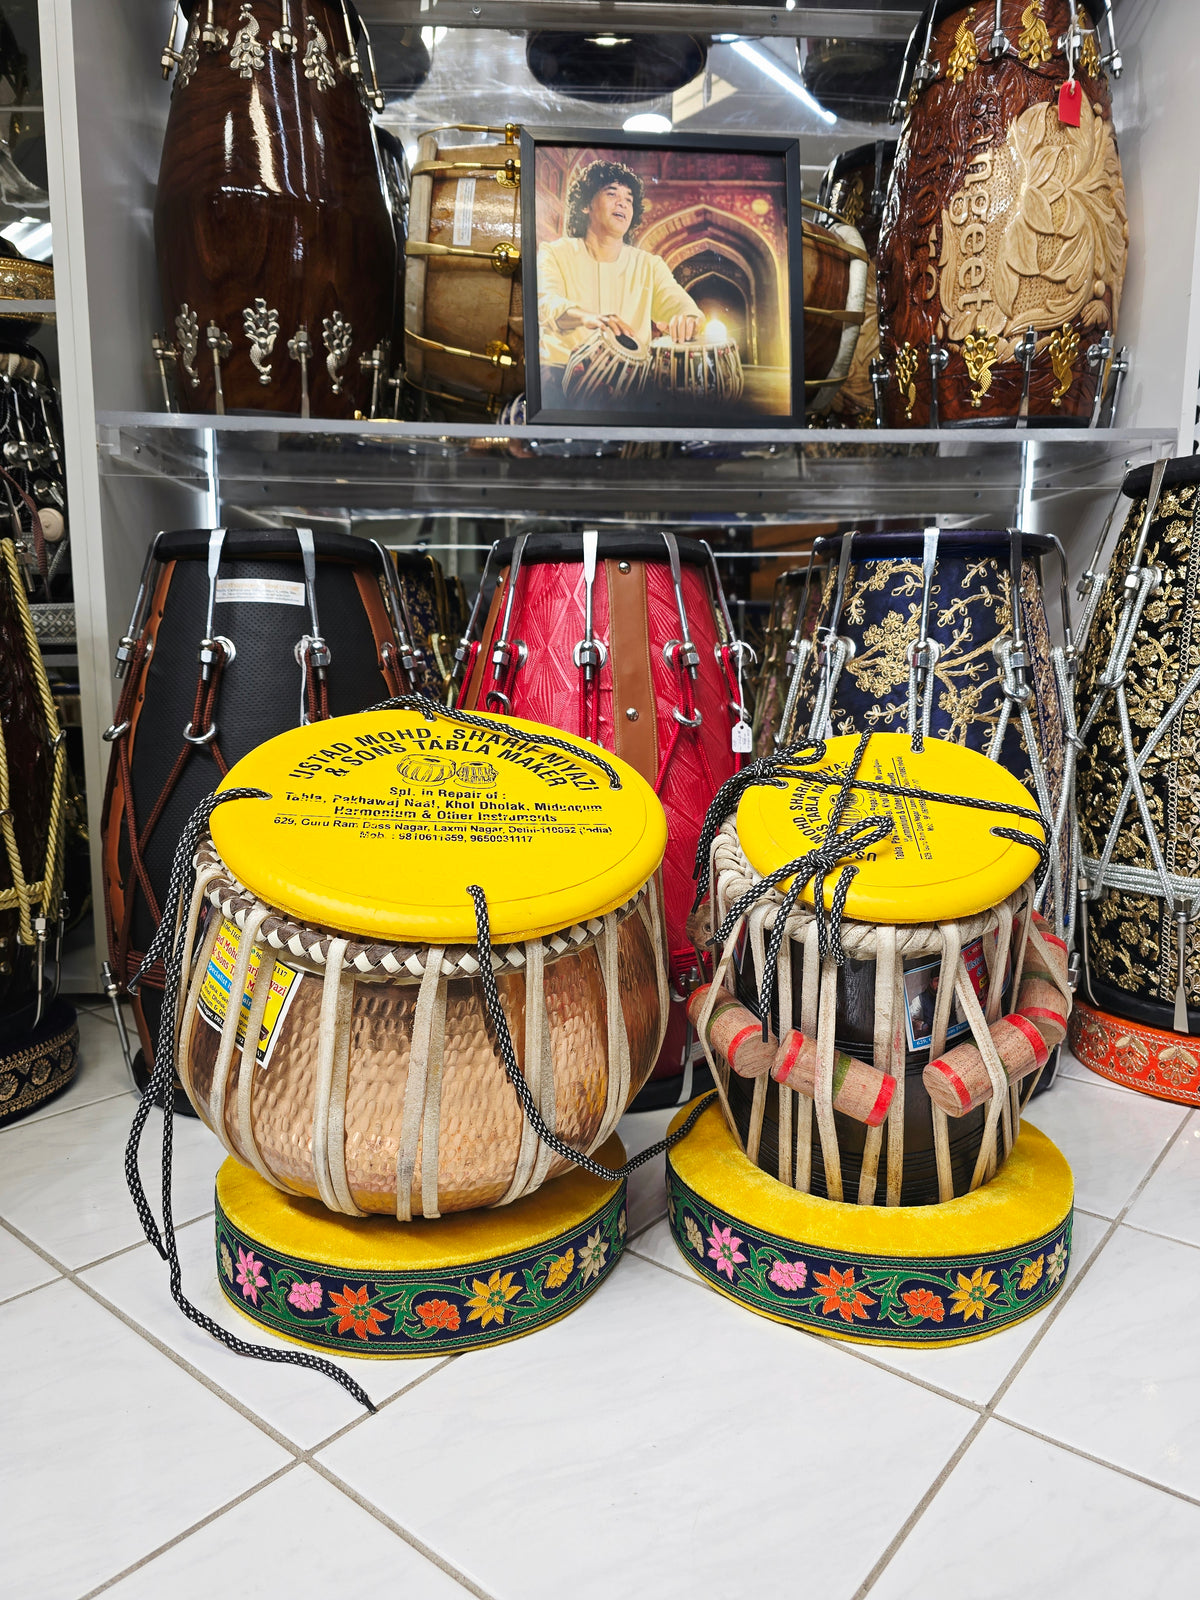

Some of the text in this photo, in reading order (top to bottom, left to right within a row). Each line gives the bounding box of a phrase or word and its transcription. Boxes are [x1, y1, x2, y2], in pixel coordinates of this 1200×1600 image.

[288, 728, 600, 791] USTAD MOHD. SHARIF NIYAZI
[324, 739, 568, 787] & SONS TABLA MAKER
[389, 786, 416, 797] Spl.
[421, 788, 433, 796] in
[438, 788, 482, 800] Repair
[445, 799, 475, 810] Khol
[804, 796, 822, 824] TABLA
[334, 806, 416, 819] Harmonium
[421, 810, 431, 819] &
[437, 810, 473, 820] Other
[301, 818, 330, 827] Guru
[333, 819, 358, 828] Ram
[395, 822, 431, 833] Nagar,
[434, 824, 467, 833] Laxmi
[470, 834, 533, 843] 9650031117
[216, 951, 229, 970] Sons
